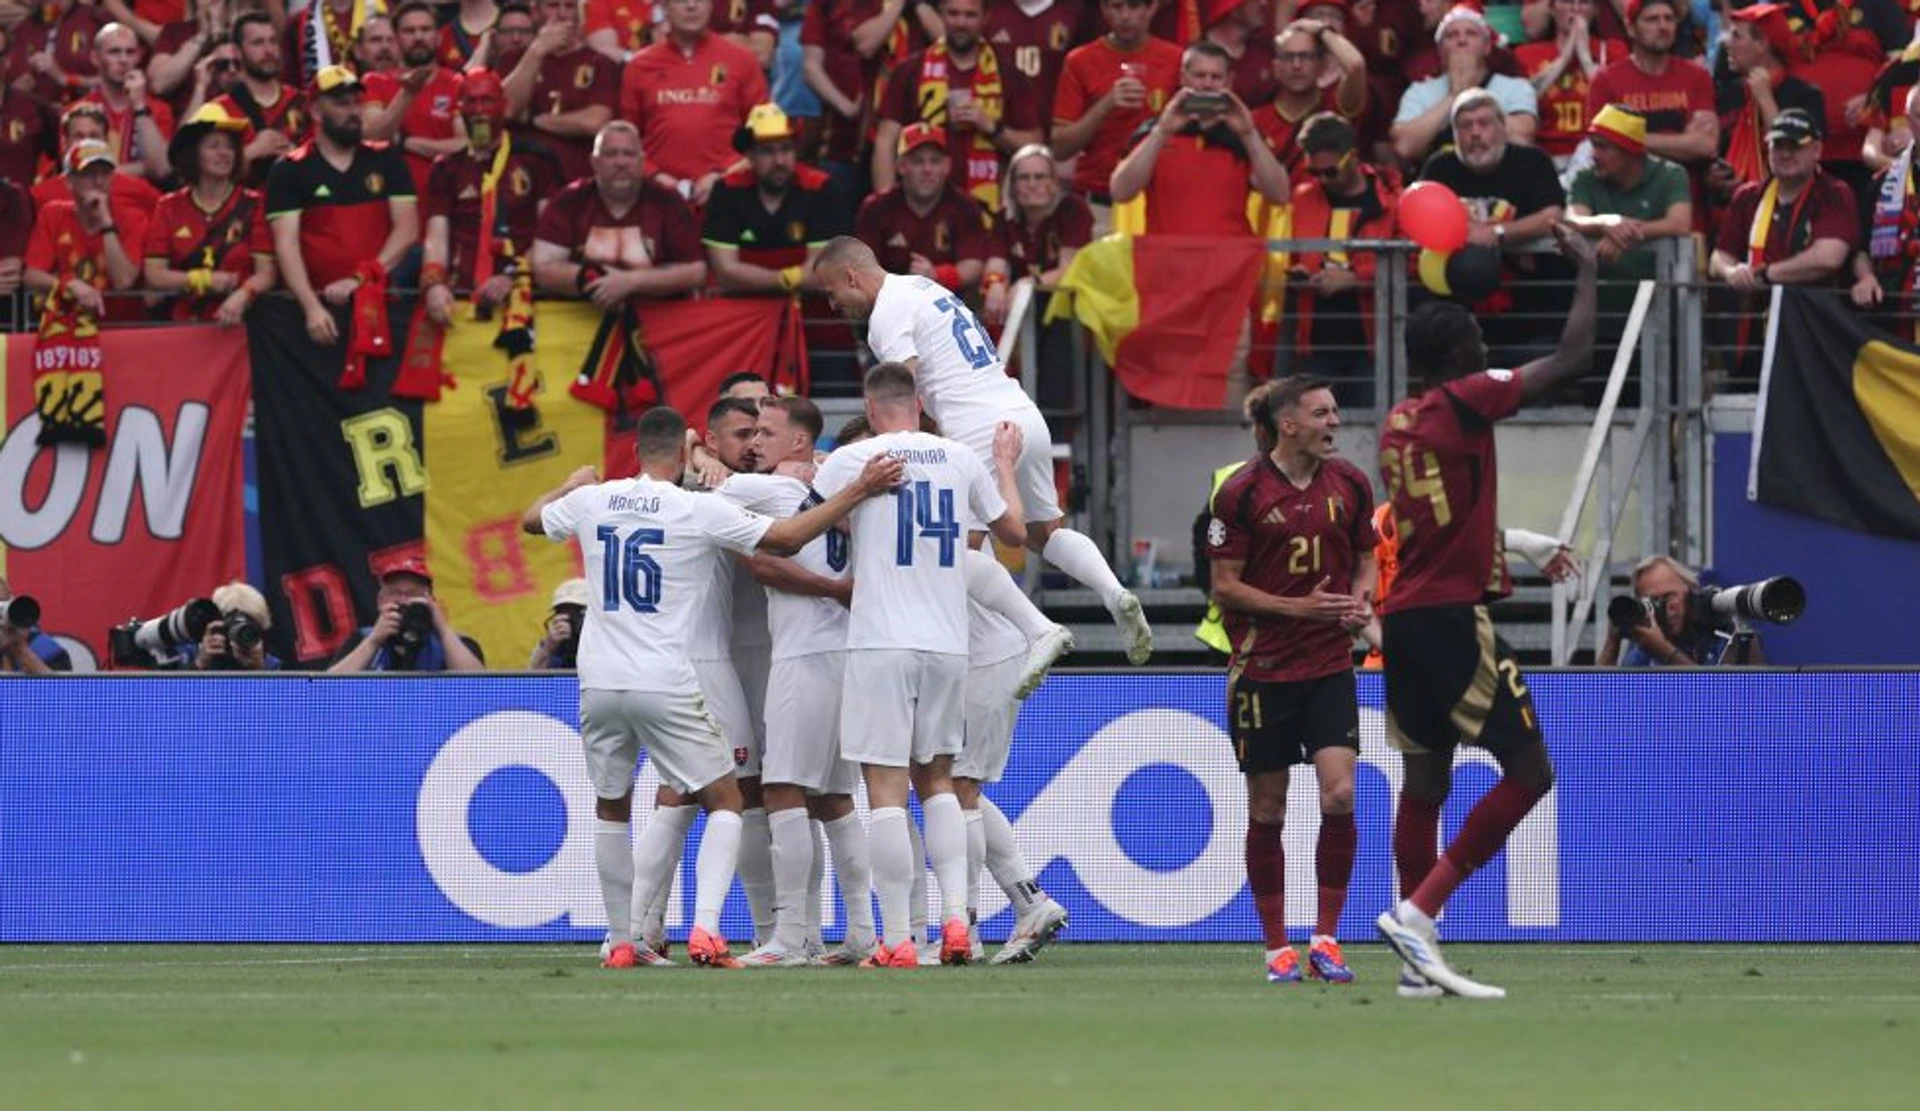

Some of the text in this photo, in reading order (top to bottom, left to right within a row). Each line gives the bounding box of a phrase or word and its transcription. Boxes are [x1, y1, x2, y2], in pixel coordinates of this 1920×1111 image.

[1553, 102, 1582, 132] 10
[889, 480, 960, 568] 14
[597, 525, 665, 614] 16
[1288, 535, 1321, 575] 21
[1236, 692, 1263, 729] 21
